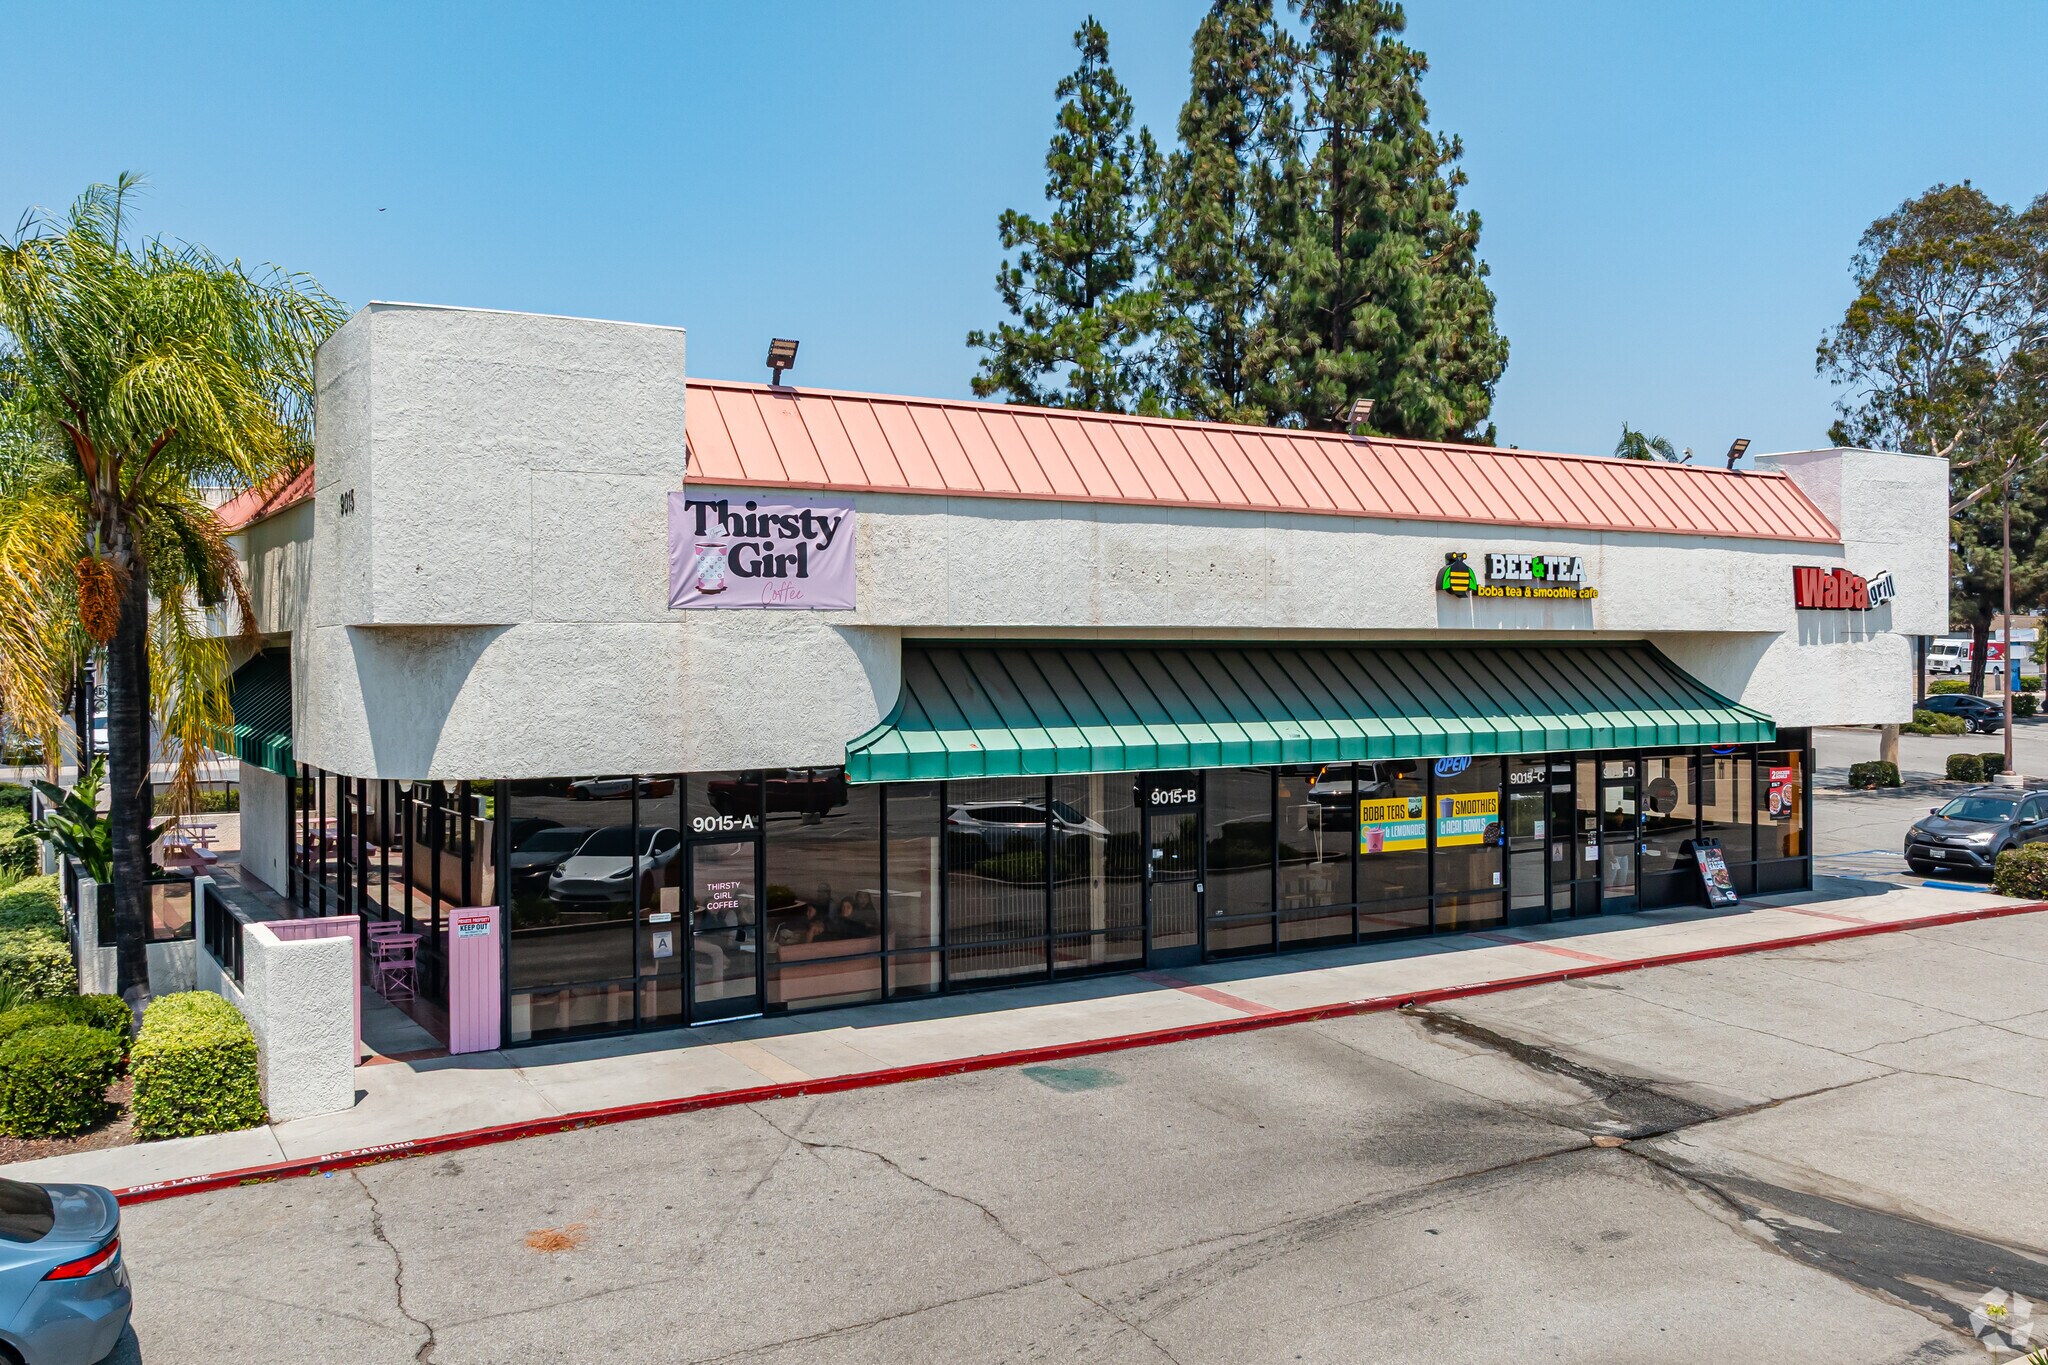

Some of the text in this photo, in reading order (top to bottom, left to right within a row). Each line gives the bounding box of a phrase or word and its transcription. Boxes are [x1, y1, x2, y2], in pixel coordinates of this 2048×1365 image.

[684, 499, 841, 550] Thirsty
[728, 541, 809, 578] Girl
[761, 581, 804, 605] Coffee
[1478, 585, 1598, 599] boba tea & smoothie cafe
[1796, 567, 1897, 609] WaBa grill
[1437, 757, 1467, 773] OPEN
[1510, 771, 1545, 784] 9015-C
[1151, 789, 1196, 805] 9015-B
[1363, 804, 1405, 822] BOBA TEAS
[1455, 799, 1496, 815] SMOOTHIES
[692, 814, 754, 832] 9015-A
[1392, 824, 1425, 837] LEMONADES
[1446, 820, 1462, 834] ACAI
[1463, 818, 1486, 832] BOWLS
[707, 881, 740, 891] THIRSTY
[713, 892, 732, 900] GIRL
[706, 900, 739, 910] COFFEE
[659, 938, 667, 948] A
[320, 1141, 414, 1161] NO PARKING
[128, 1174, 212, 1193] FIRE LANE
